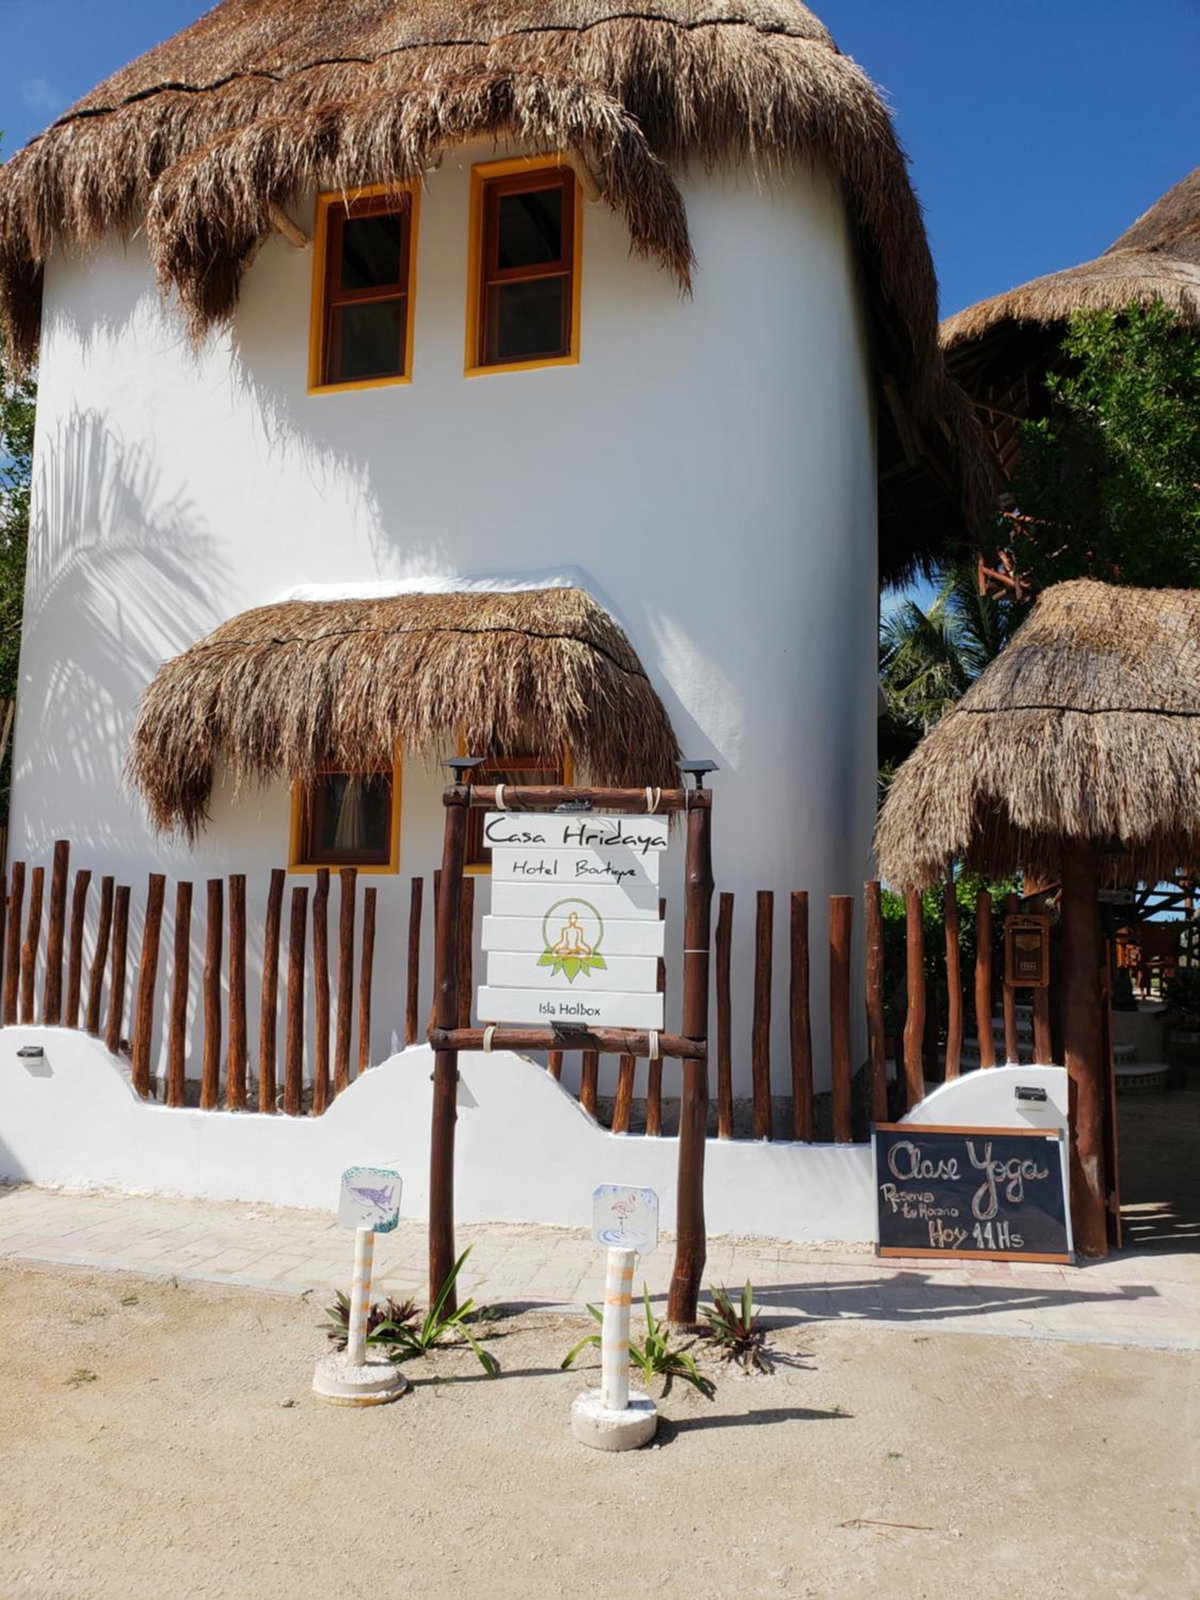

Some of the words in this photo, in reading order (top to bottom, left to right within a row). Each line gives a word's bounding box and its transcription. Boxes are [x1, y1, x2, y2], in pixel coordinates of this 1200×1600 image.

[485, 817, 546, 844] Casa
[562, 819, 667, 855] Hridaya
[512, 859, 558, 876] Hotel
[575, 859, 637, 884] Boutique
[538, 1001, 556, 1015] Isla
[559, 1002, 601, 1016] Holbox
[887, 1140, 961, 1181] Clase
[964, 1140, 1049, 1220] Yoga
[880, 1182, 935, 1213] Reserva
[901, 1202, 918, 1219] tu
[928, 1219, 969, 1250] Hoy
